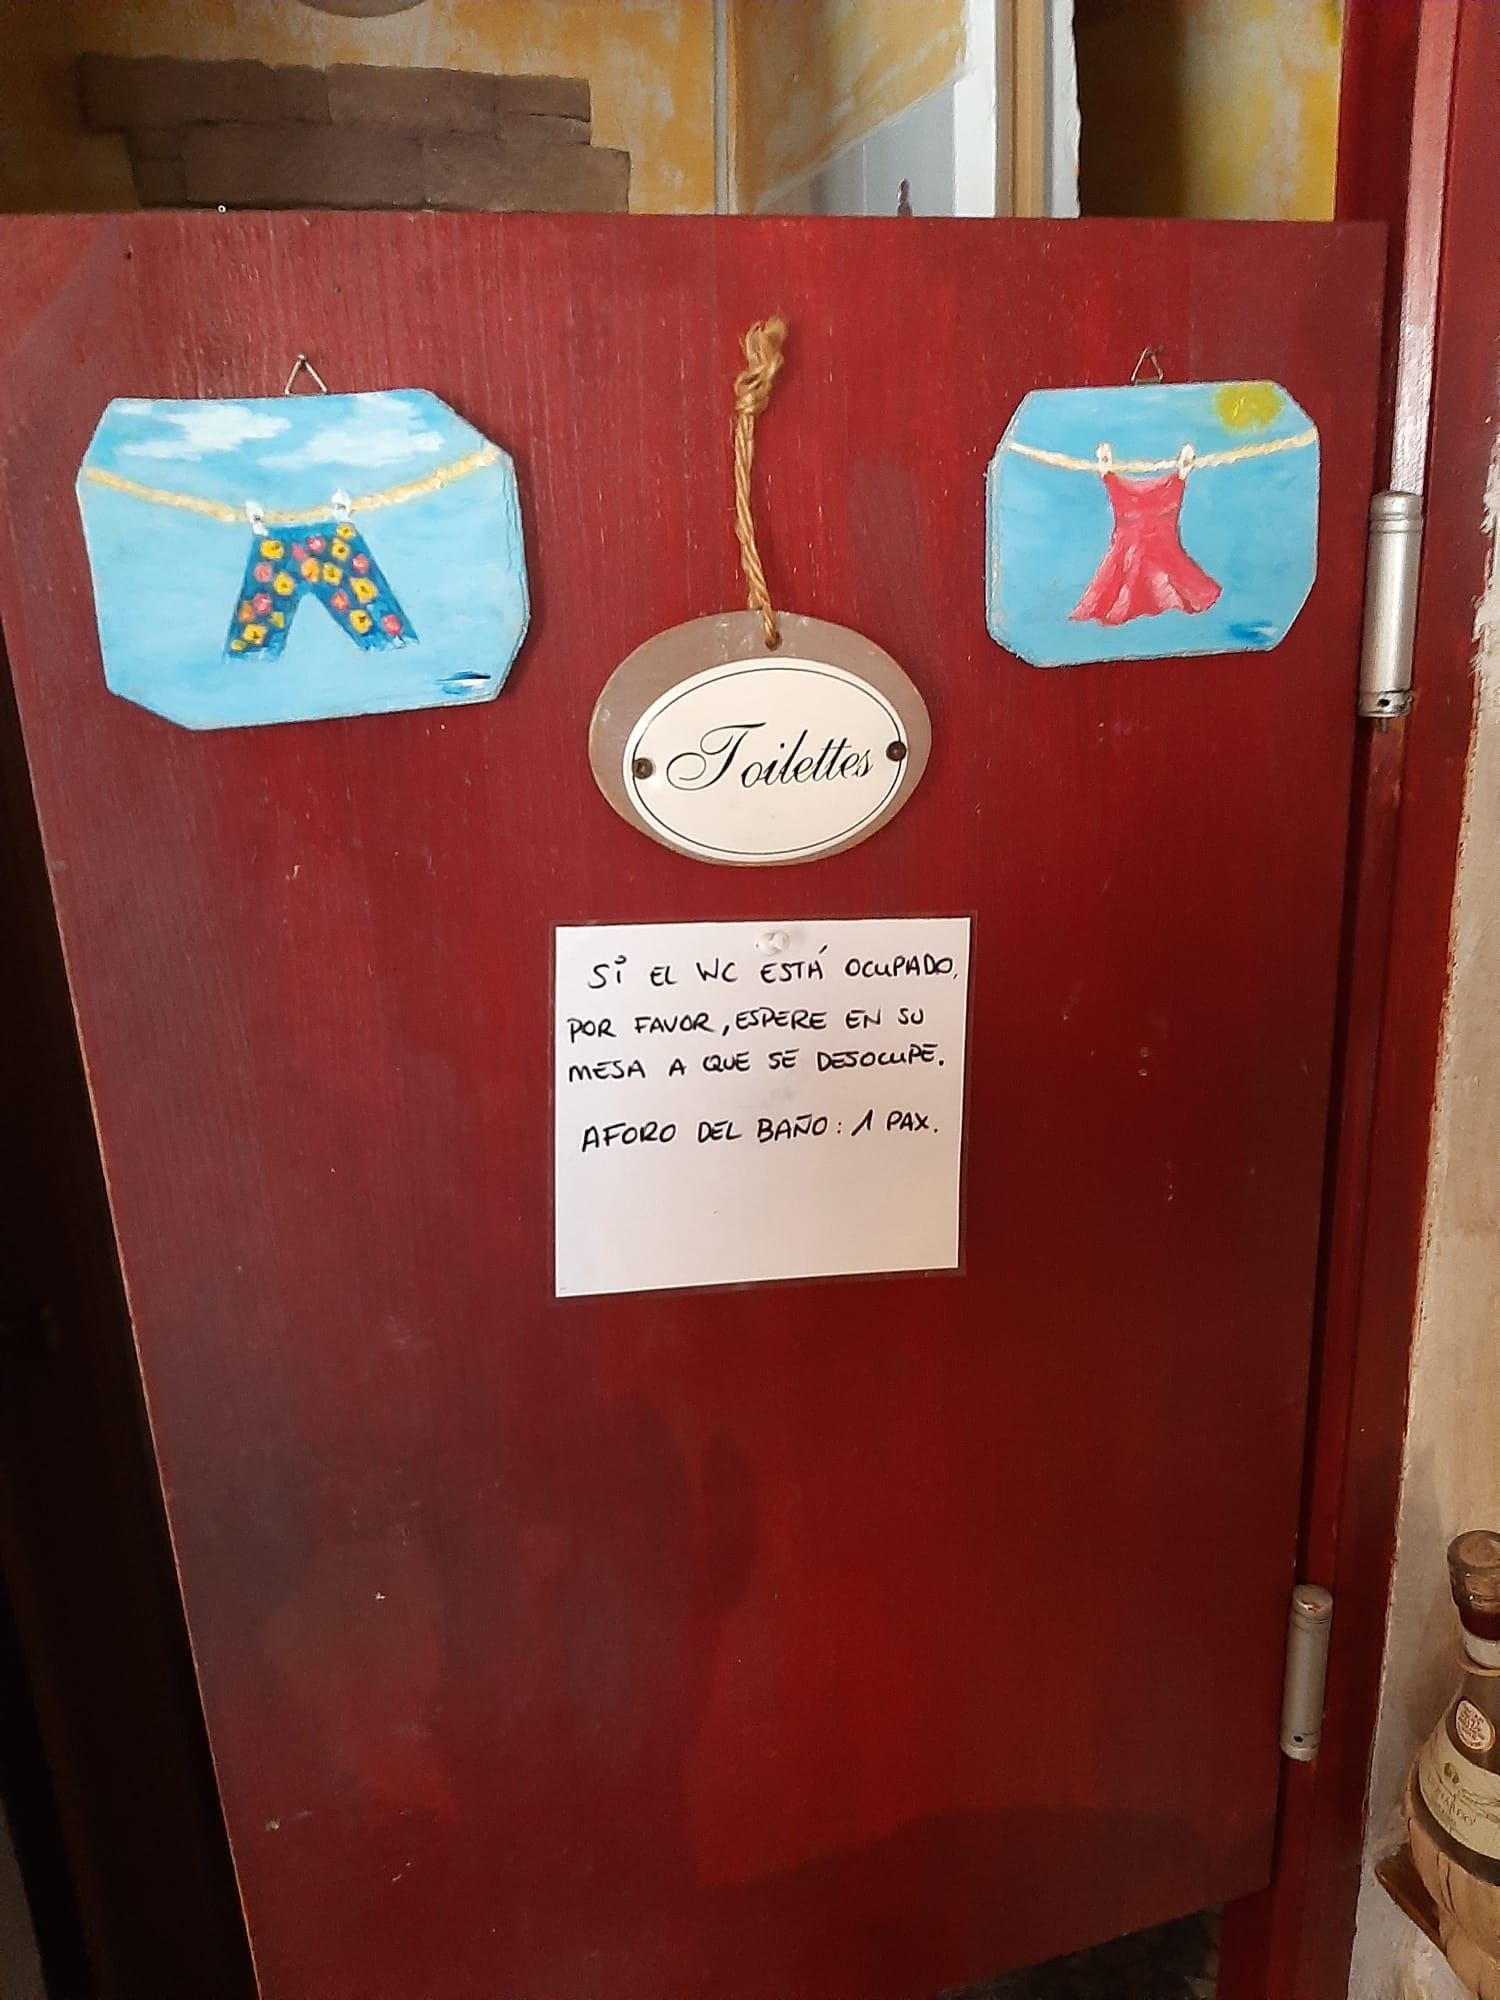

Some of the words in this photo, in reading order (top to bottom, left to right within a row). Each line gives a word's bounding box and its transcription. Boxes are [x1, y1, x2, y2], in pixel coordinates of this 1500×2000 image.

[665, 721, 874, 792] Toilettes
[649, 965, 678, 988] EL
[695, 957, 739, 983] WC
[760, 944, 829, 984] ESTÁ
[566, 1017, 617, 1045] POR
[845, 1007, 882, 1030] EN
[897, 1007, 925, 1026] SU
[568, 1059, 647, 1083] MESA
[668, 1057, 688, 1078] A
[702, 1050, 751, 1073] QUE
[767, 1047, 801, 1071] SE
[816, 1043, 945, 1073] DESOCUPE.
[581, 1120, 677, 1153] AFORO
[697, 1119, 743, 1144] DEL
[850, 1108, 874, 1137] 1
[886, 1109, 939, 1134] PAX.
